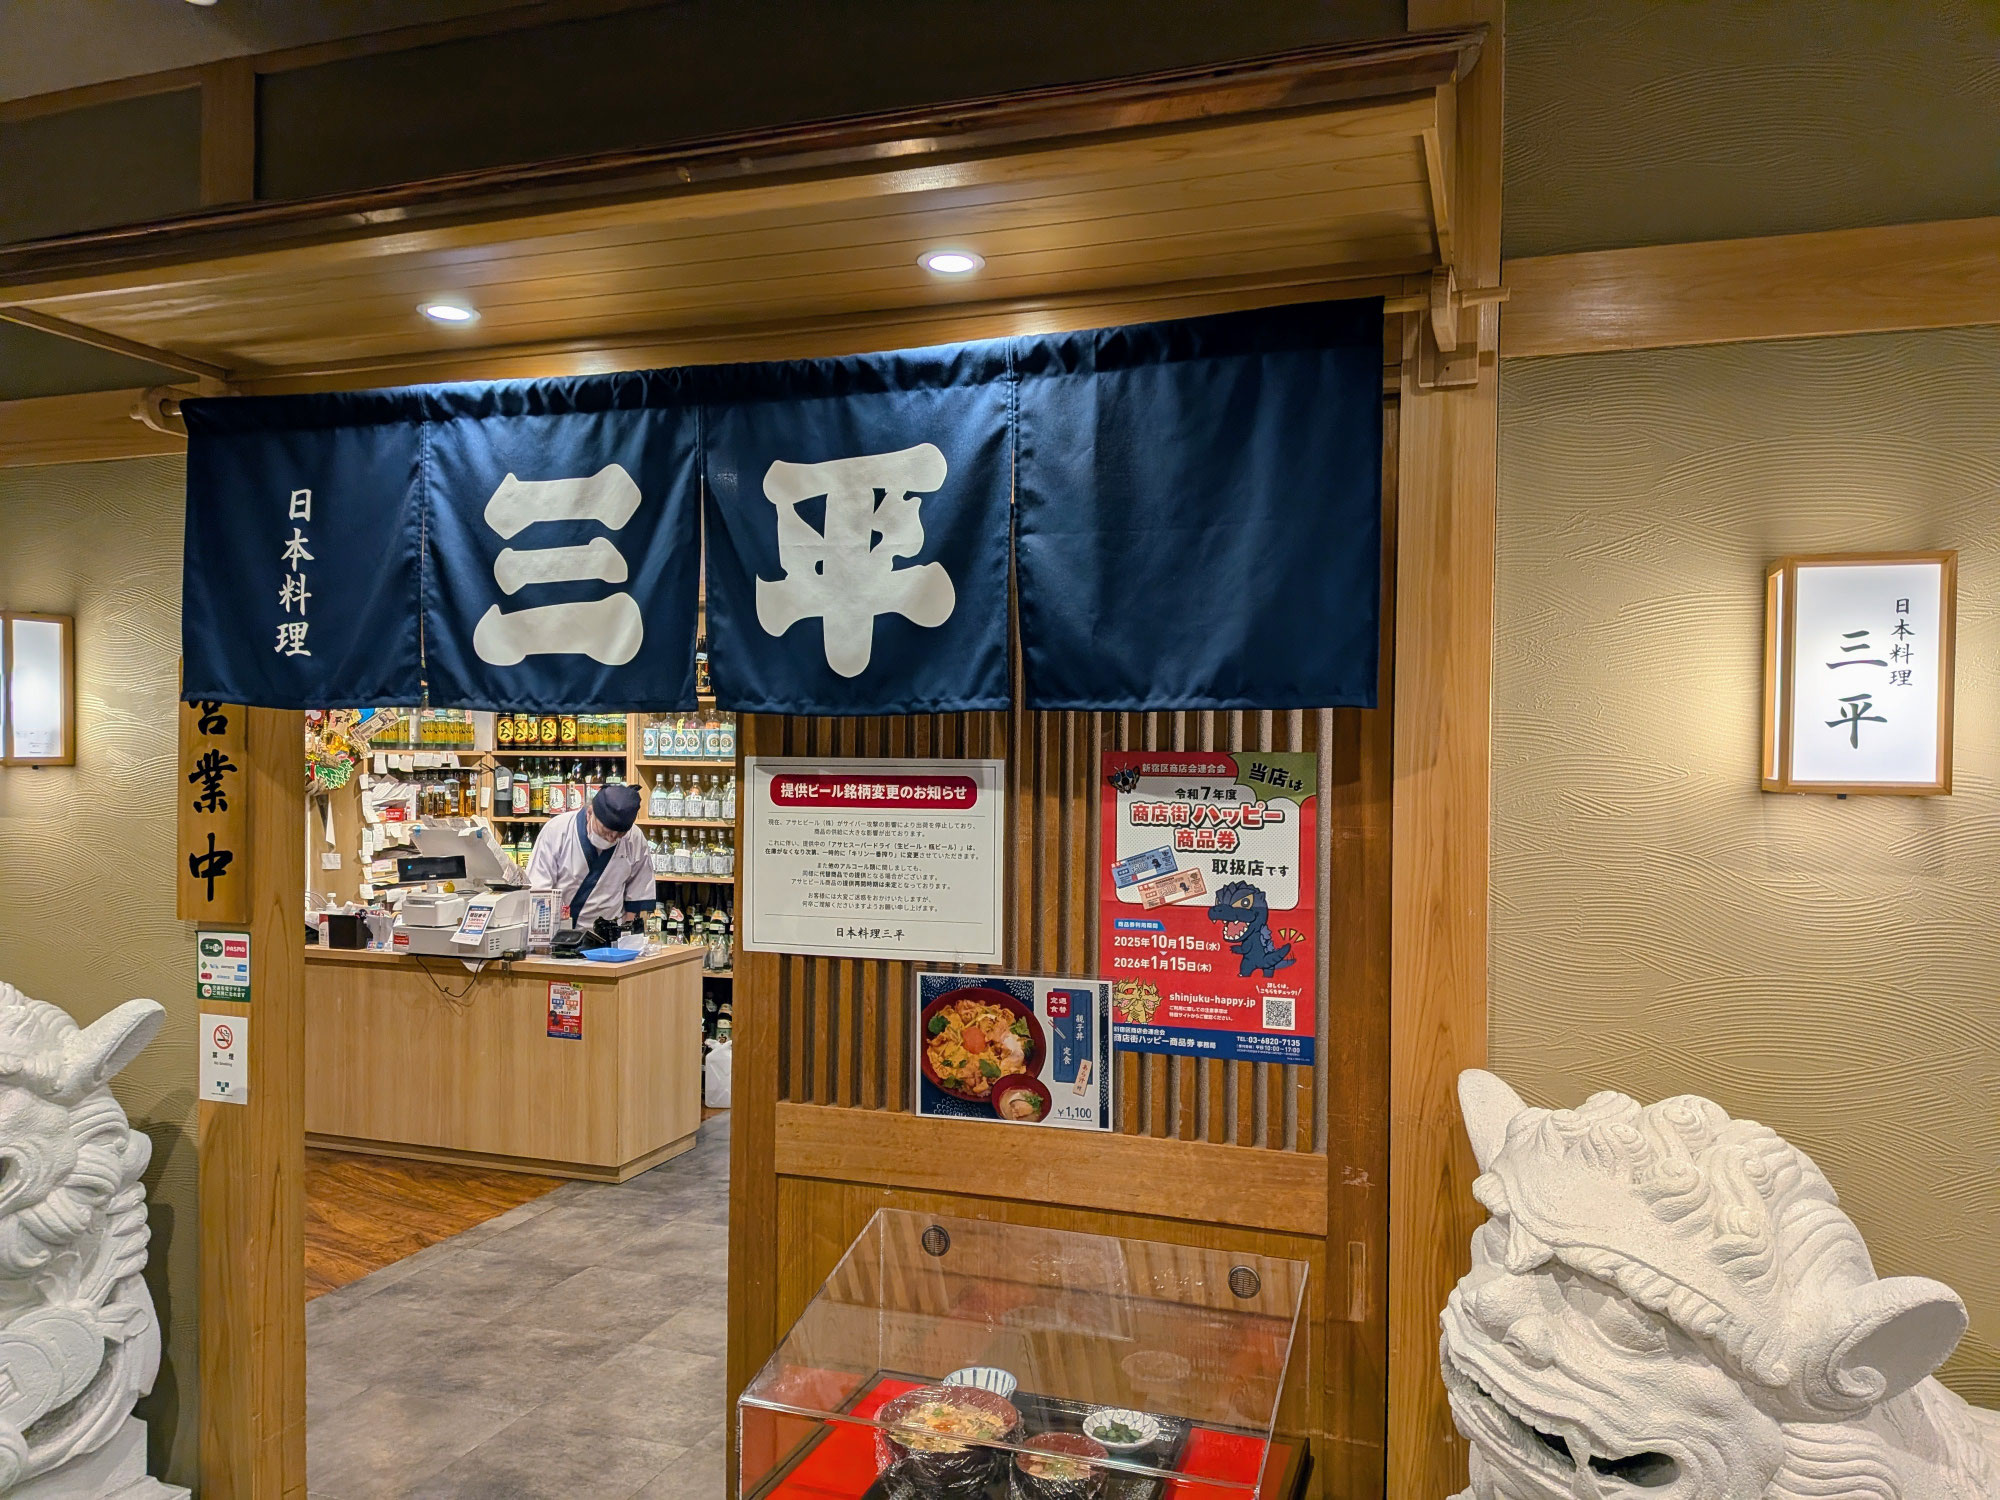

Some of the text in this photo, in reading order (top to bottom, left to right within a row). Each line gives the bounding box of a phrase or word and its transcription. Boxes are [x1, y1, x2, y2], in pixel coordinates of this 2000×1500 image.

[274, 488, 315, 658] 日本料理
[1888, 598, 1916, 687] 日本料理
[1825, 630, 1889, 750] 三平
[1141, 763, 1227, 774] 新宿区商店会連合会
[1249, 762, 1304, 792] 当店は
[780, 783, 968, 800] 提供ビール銘柄変更のお知らせ
[1174, 786, 1238, 800] 令和7年度
[1131, 802, 1284, 828] 商店街ハッピー
[1176, 828, 1238, 850] 商品券
[1212, 858, 1290, 878] 取扱店です
[836, 926, 905, 941] 日本料理三平
[1114, 935, 1220, 951] 2025年10月15日(水)
[1114, 956, 1212, 972] 2026年1月15日(木)
[1169, 993, 1256, 1007] shinjuku-happy.jp
[1075, 1014, 1085, 1041] 親子丼
[1113, 1034, 1195, 1048] 商店街ハッピー商品券
[1063, 1046, 1072, 1065] 定食
